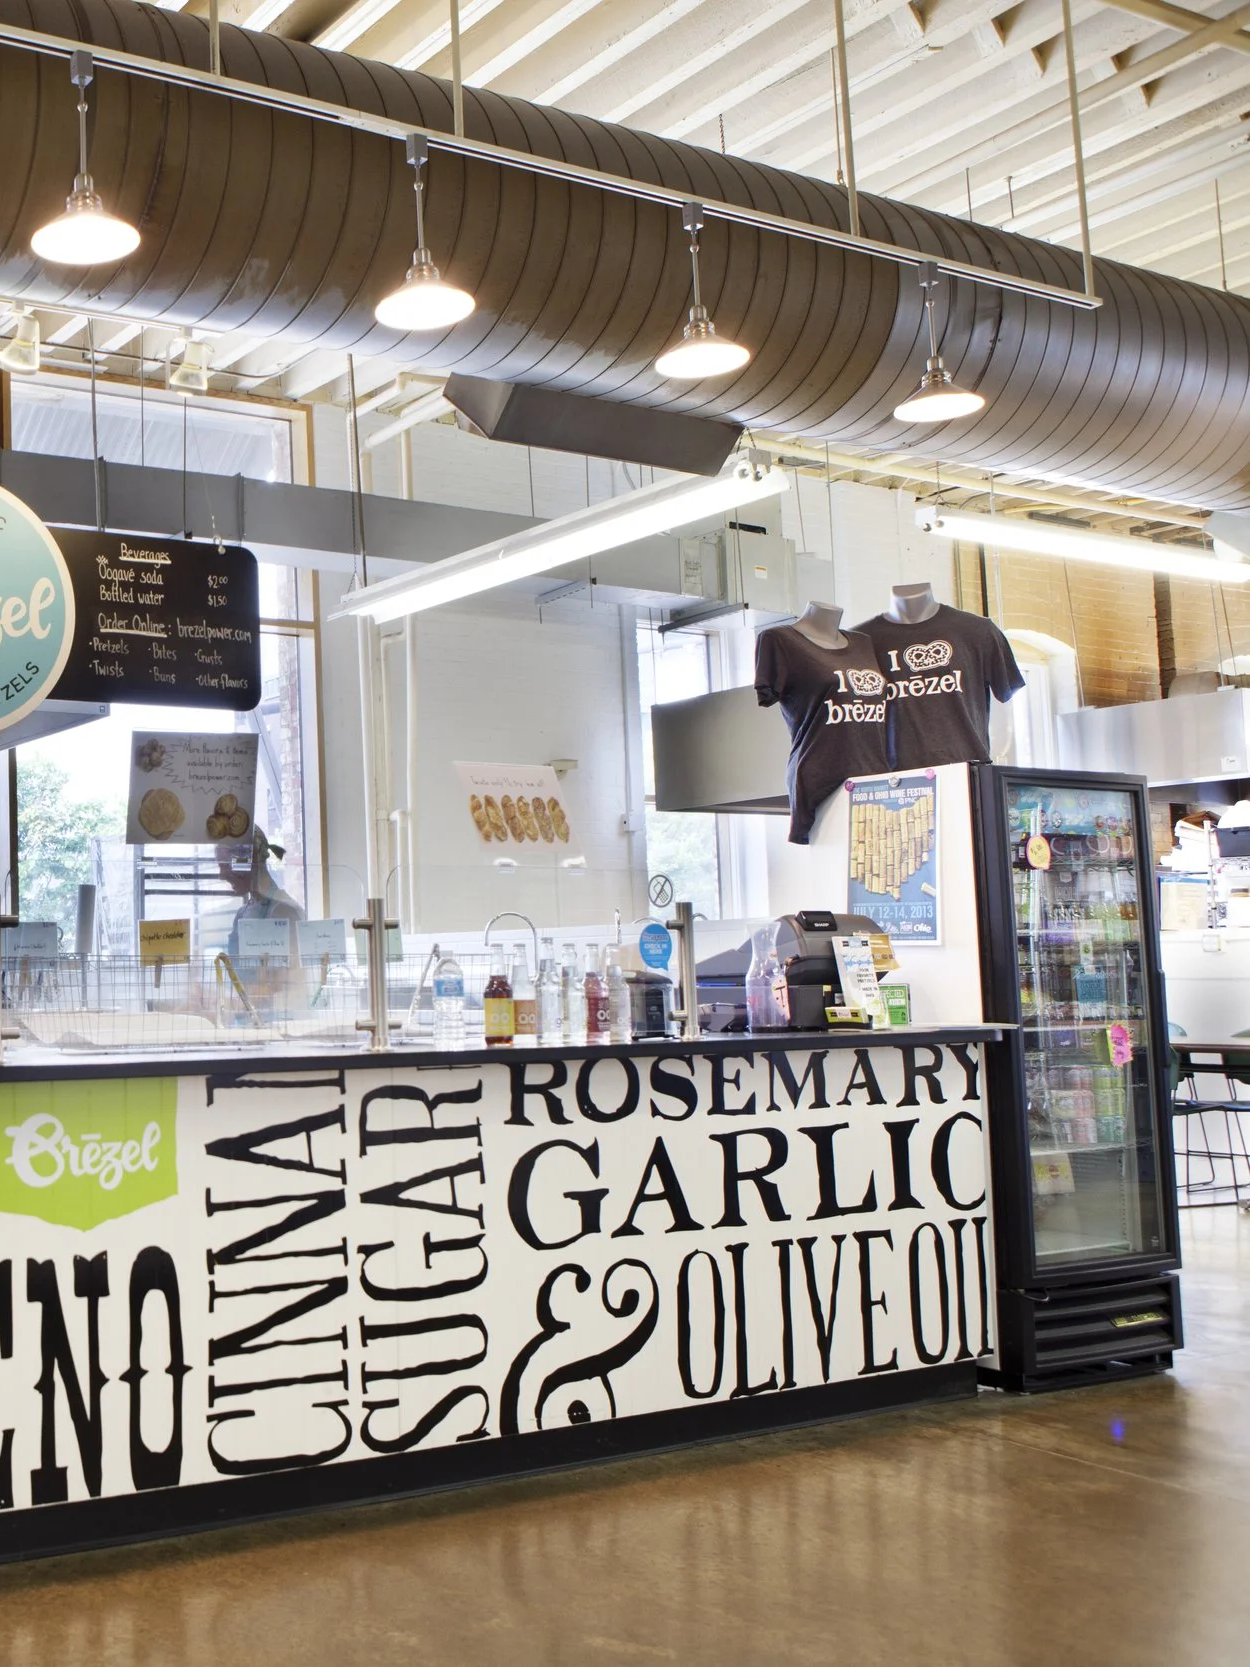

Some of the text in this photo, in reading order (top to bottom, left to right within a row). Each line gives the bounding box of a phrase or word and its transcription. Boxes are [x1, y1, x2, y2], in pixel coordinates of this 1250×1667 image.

[120, 542, 171, 569] Beverages
[139, 570, 164, 585] soda
[207, 575, 229, 589] $2.00
[99, 584, 135, 604] Bottled
[138, 590, 165, 606] water
[97, 612, 129, 630] Order
[176, 617, 252, 644] brezelpower.com
[92, 636, 130, 655] Pretzels
[152, 642, 178, 661] Bites
[888, 650, 901, 672] I
[92, 659, 125, 679] Twists
[153, 666, 176, 684] Buns
[853, 792, 868, 802] FOOD
[874, 790, 889, 800] OHIO
[890, 788, 906, 799] WINE
[906, 786, 935, 797] FESTIVAL
[910, 905, 934, 918] 2013
[498, 1042, 981, 1127] ROSEMARY
[506, 1110, 986, 1251] GARLIC
[356, 1078, 491, 1454] SUGAR
[499, 1257, 660, 1438] &
[676, 1229, 899, 1400] OLIVE
